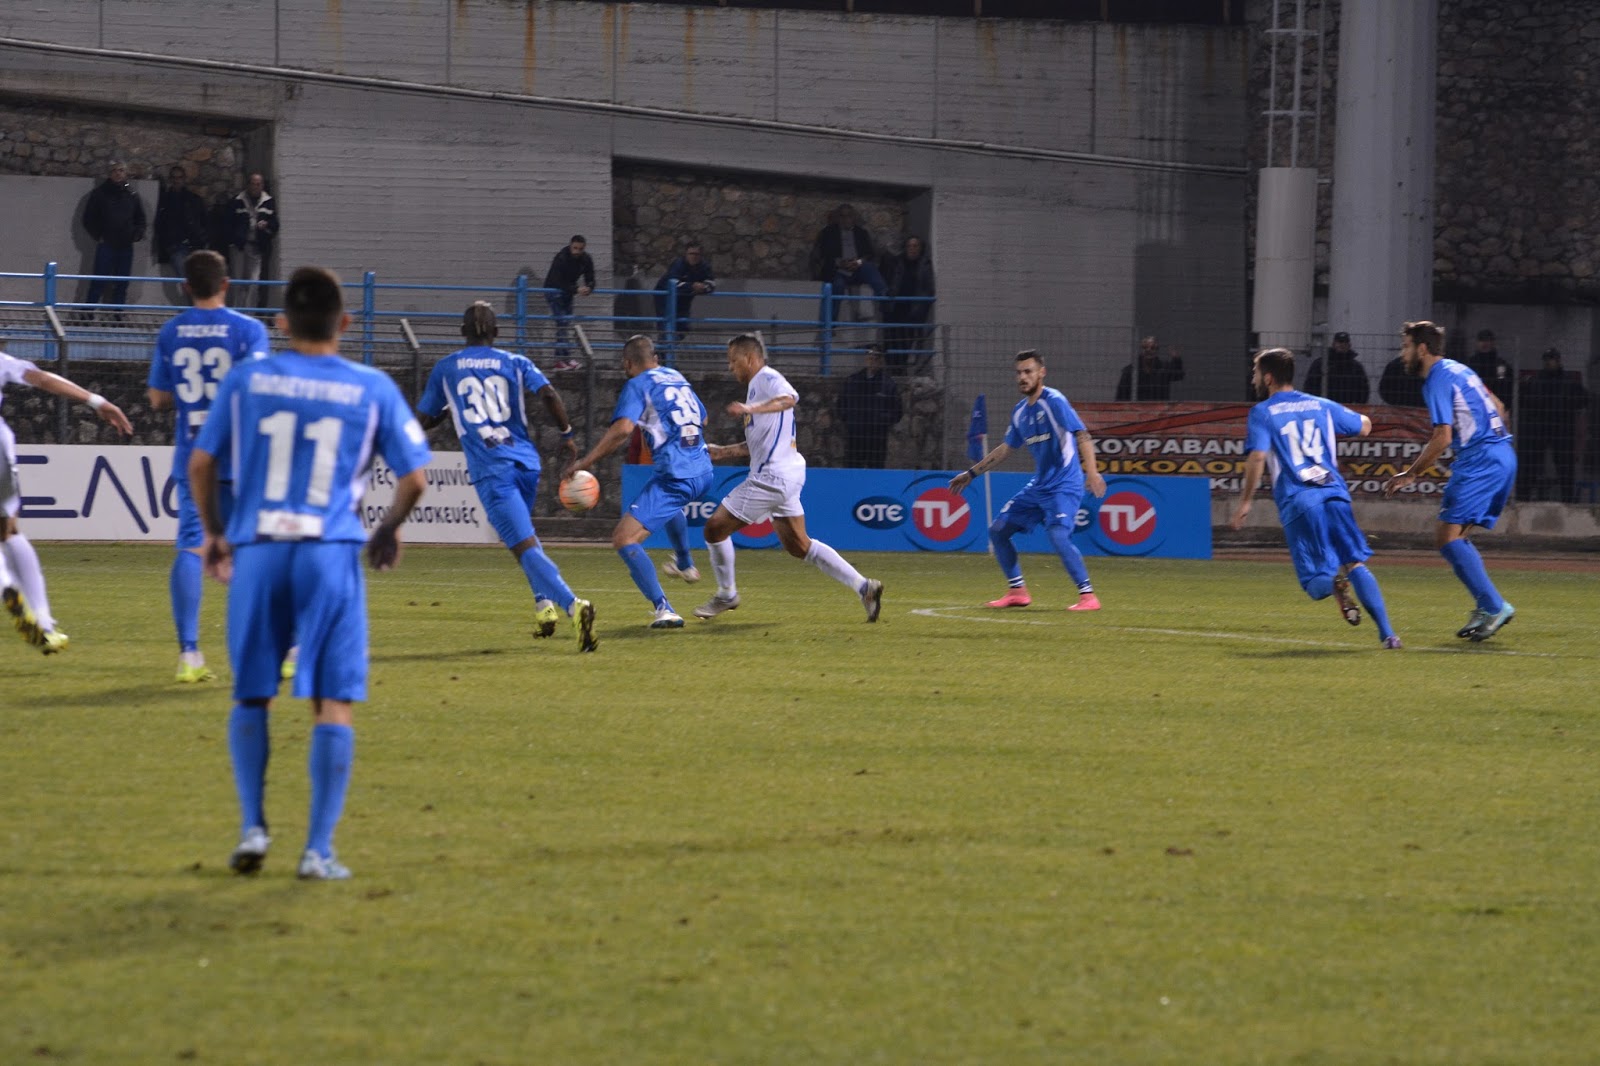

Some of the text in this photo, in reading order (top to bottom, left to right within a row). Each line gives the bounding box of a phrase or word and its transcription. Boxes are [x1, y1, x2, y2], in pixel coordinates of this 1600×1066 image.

[172, 346, 232, 404] 33
[456, 374, 511, 424] 30
[258, 410, 343, 507] 11
[1279, 418, 1324, 467] 14
[912, 500, 971, 529] TV
[1099, 504, 1156, 533] TV
